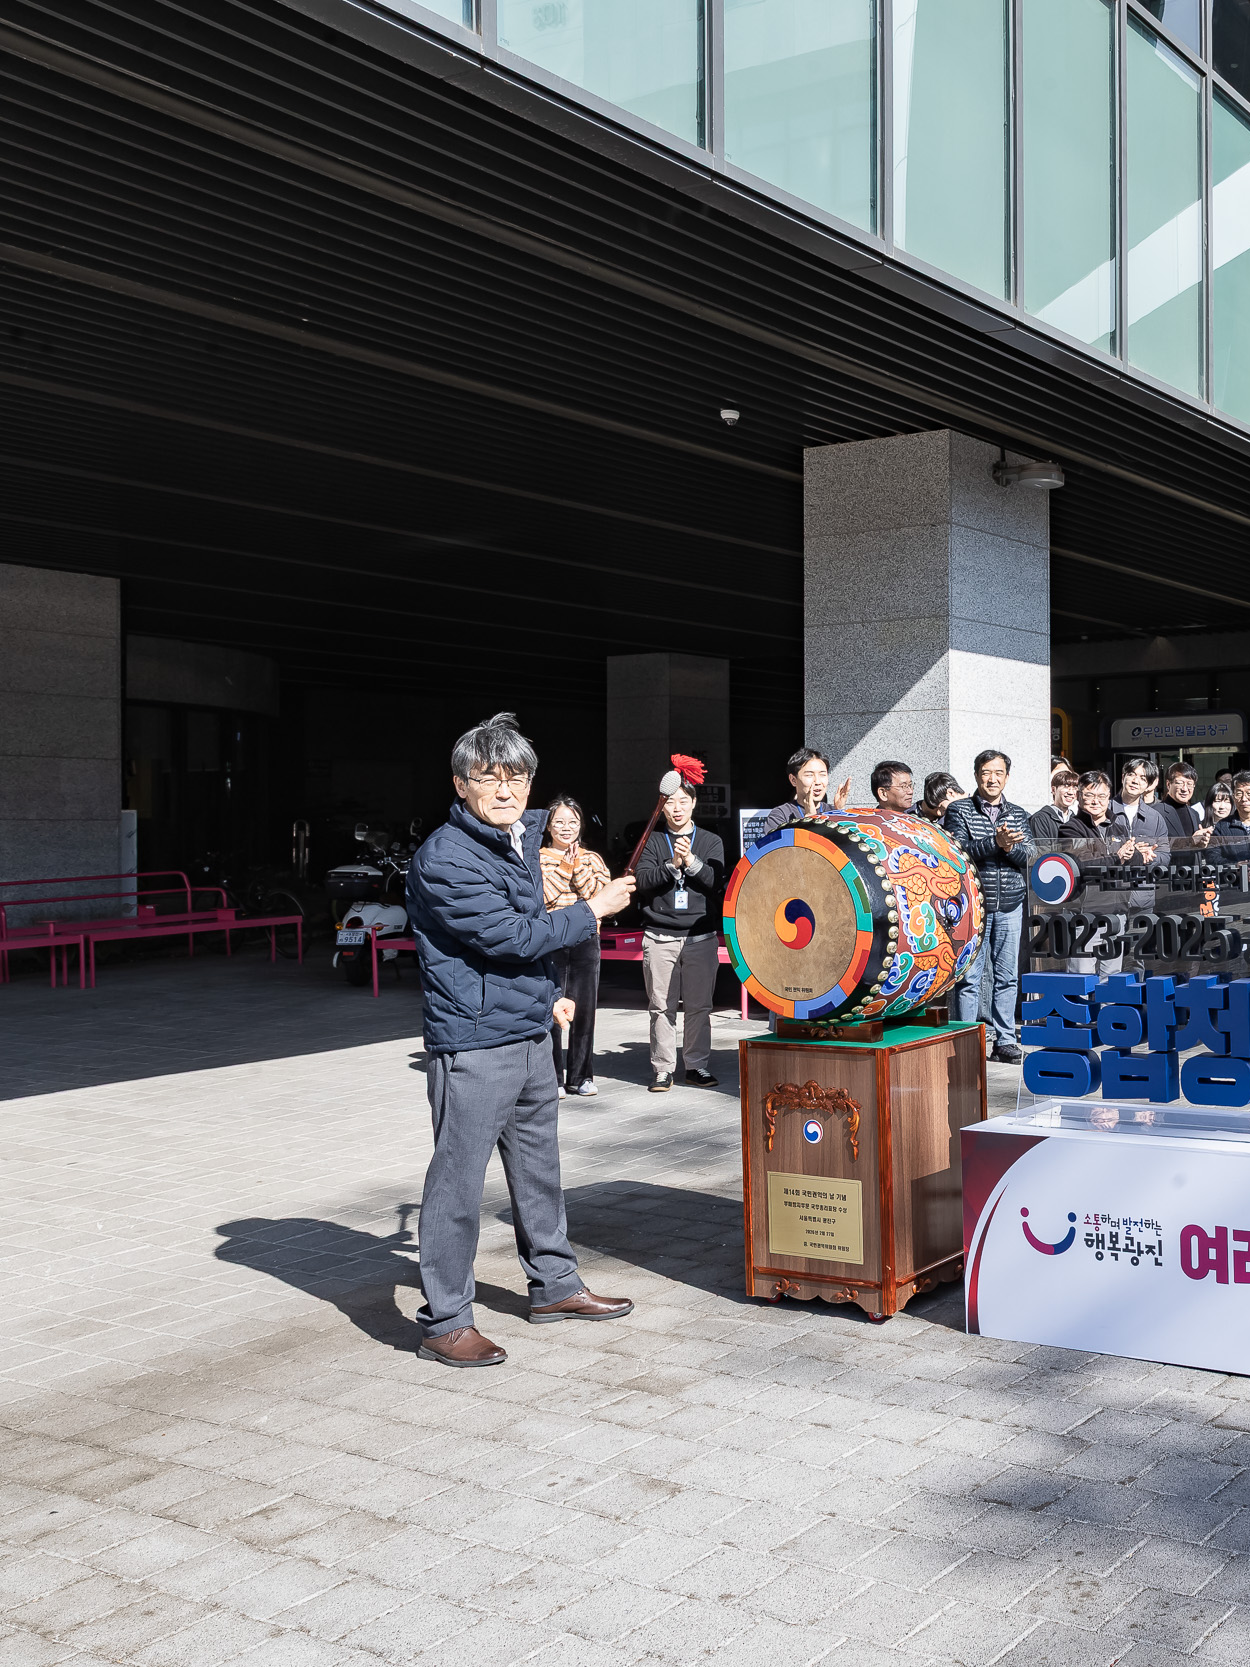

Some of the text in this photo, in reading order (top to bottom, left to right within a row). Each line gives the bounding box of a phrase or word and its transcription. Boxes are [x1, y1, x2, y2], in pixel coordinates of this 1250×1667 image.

[1083, 1213, 1162, 1236] 소통하며 발전하는
[1084, 1231, 1163, 1266] 행복광진
